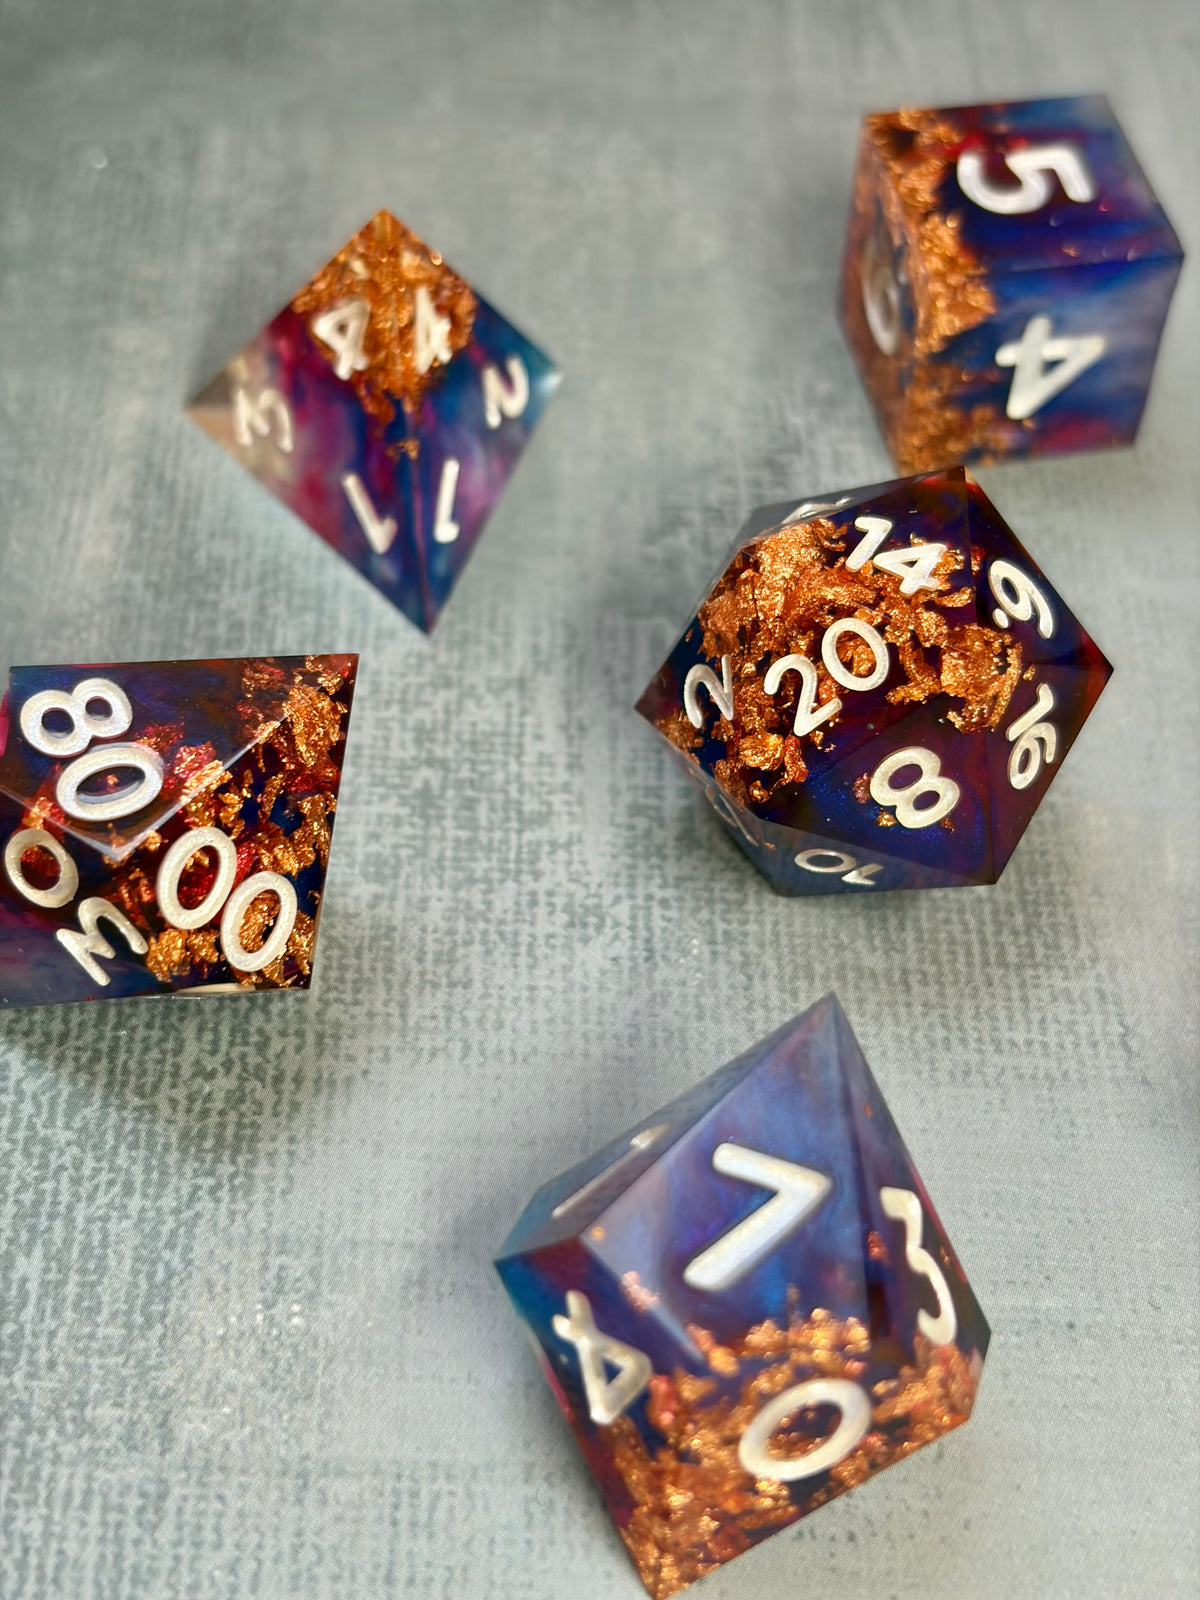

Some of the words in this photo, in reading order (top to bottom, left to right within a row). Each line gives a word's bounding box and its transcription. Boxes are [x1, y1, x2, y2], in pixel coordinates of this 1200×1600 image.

[957, 145, 1094, 214] 5
[312, 300, 369, 380] 4
[996, 315, 1109, 420] 4
[482, 355, 529, 428] 2
[342, 473, 397, 554] 1
[434, 457, 460, 543] 1
[844, 516, 948, 596] 14
[683, 655, 735, 729] 2
[763, 617, 889, 737] 20
[1005, 683, 1058, 790] 16
[869, 746, 961, 829] 8
[157, 826, 298, 972] 00
[683, 1142, 833, 1291] 7
[880, 1186, 957, 1345] 3
[551, 1289, 652, 1425] 4
[737, 1377, 871, 1482] 0
